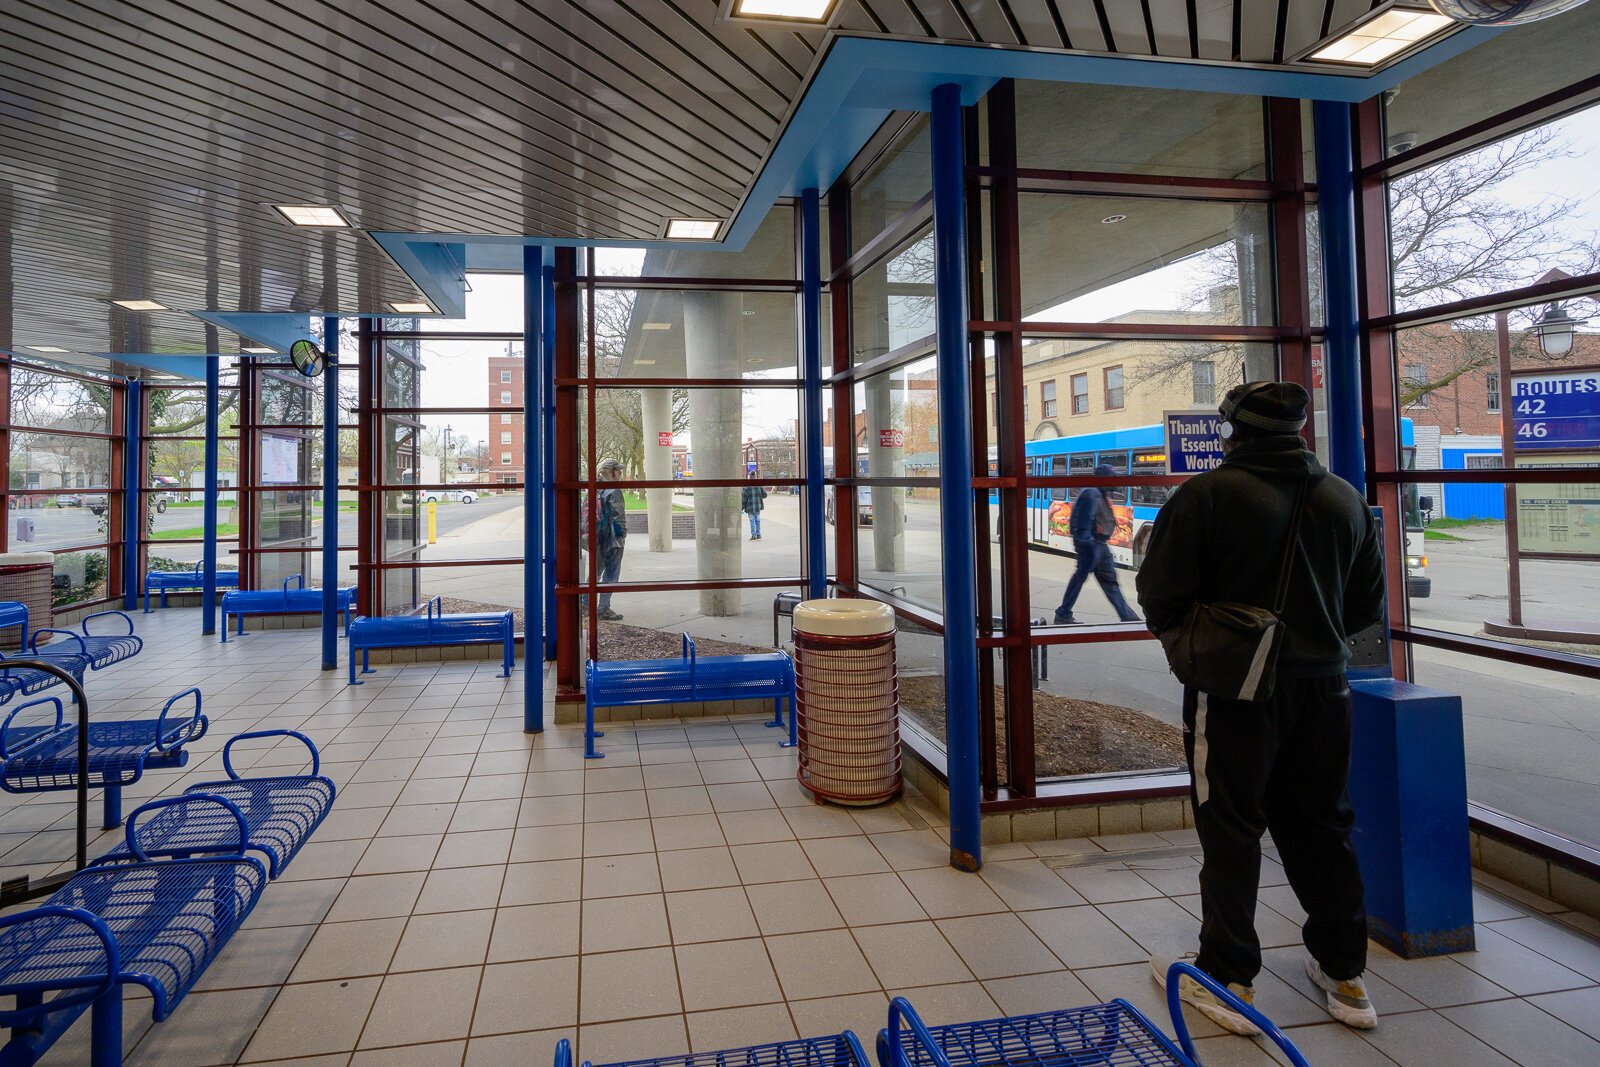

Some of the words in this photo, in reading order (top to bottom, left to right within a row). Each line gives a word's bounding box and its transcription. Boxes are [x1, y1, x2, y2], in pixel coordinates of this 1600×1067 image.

[1517, 378, 1598, 396] ROUTES
[1517, 399, 1546, 415] 42
[1169, 420, 1206, 435] Thank
[1208, 420, 1221, 435] Yo
[1518, 422, 1548, 438] 46
[1181, 438, 1223, 452] Essenti
[1185, 455, 1222, 470] Worke
